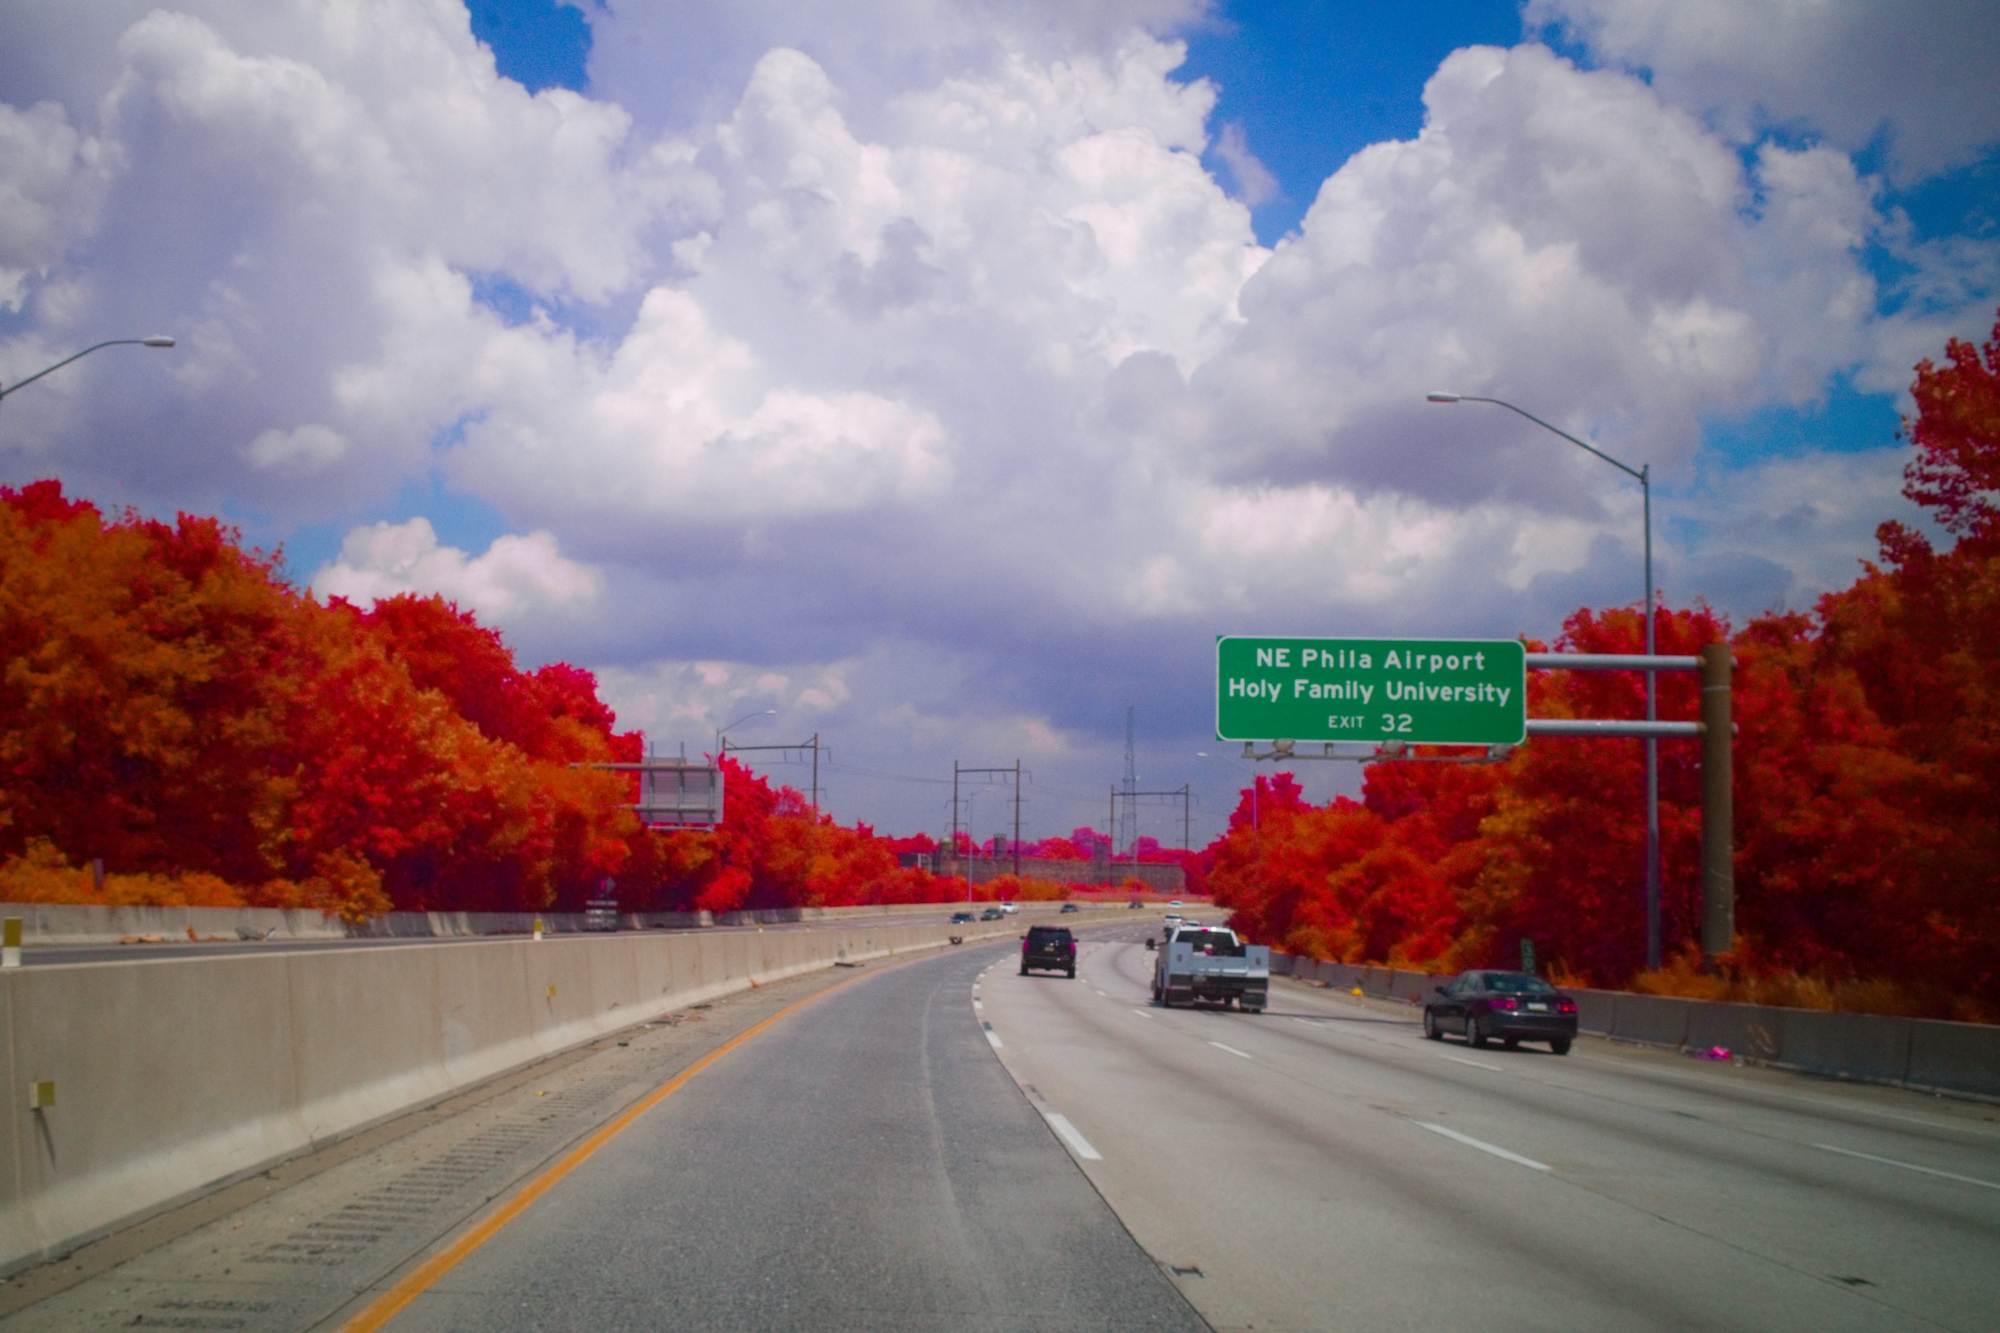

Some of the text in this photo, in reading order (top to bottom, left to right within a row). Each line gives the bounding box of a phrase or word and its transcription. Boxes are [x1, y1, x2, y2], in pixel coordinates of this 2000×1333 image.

[1256, 648, 1485, 673] NE Phila Airport
[1229, 677, 1511, 707] Holy Family University
[1328, 713, 1413, 732] EXIT 32
